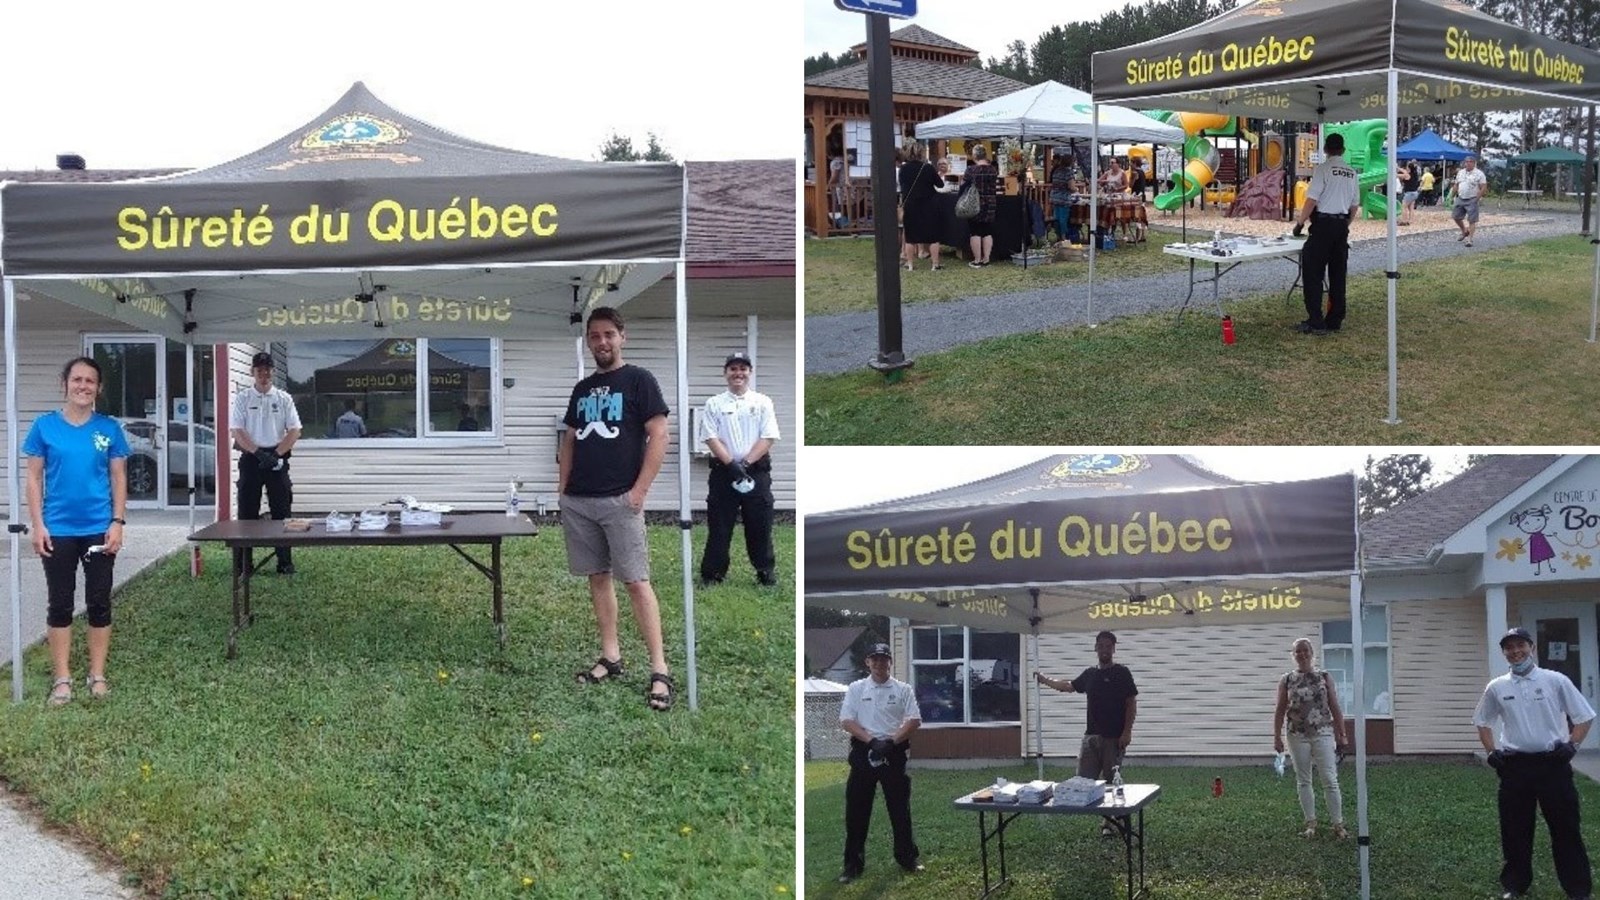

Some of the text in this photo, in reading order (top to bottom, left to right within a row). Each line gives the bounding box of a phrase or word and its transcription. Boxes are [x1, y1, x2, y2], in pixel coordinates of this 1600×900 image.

[1126, 36, 1316, 86] Sûreté du Québec
[1445, 26, 1584, 85] Sûreté du Québec
[117, 197, 558, 250] Sûreté du Québec
[577, 393, 623, 422] PAPA
[847, 511, 1233, 569] Sûreté du Québec
